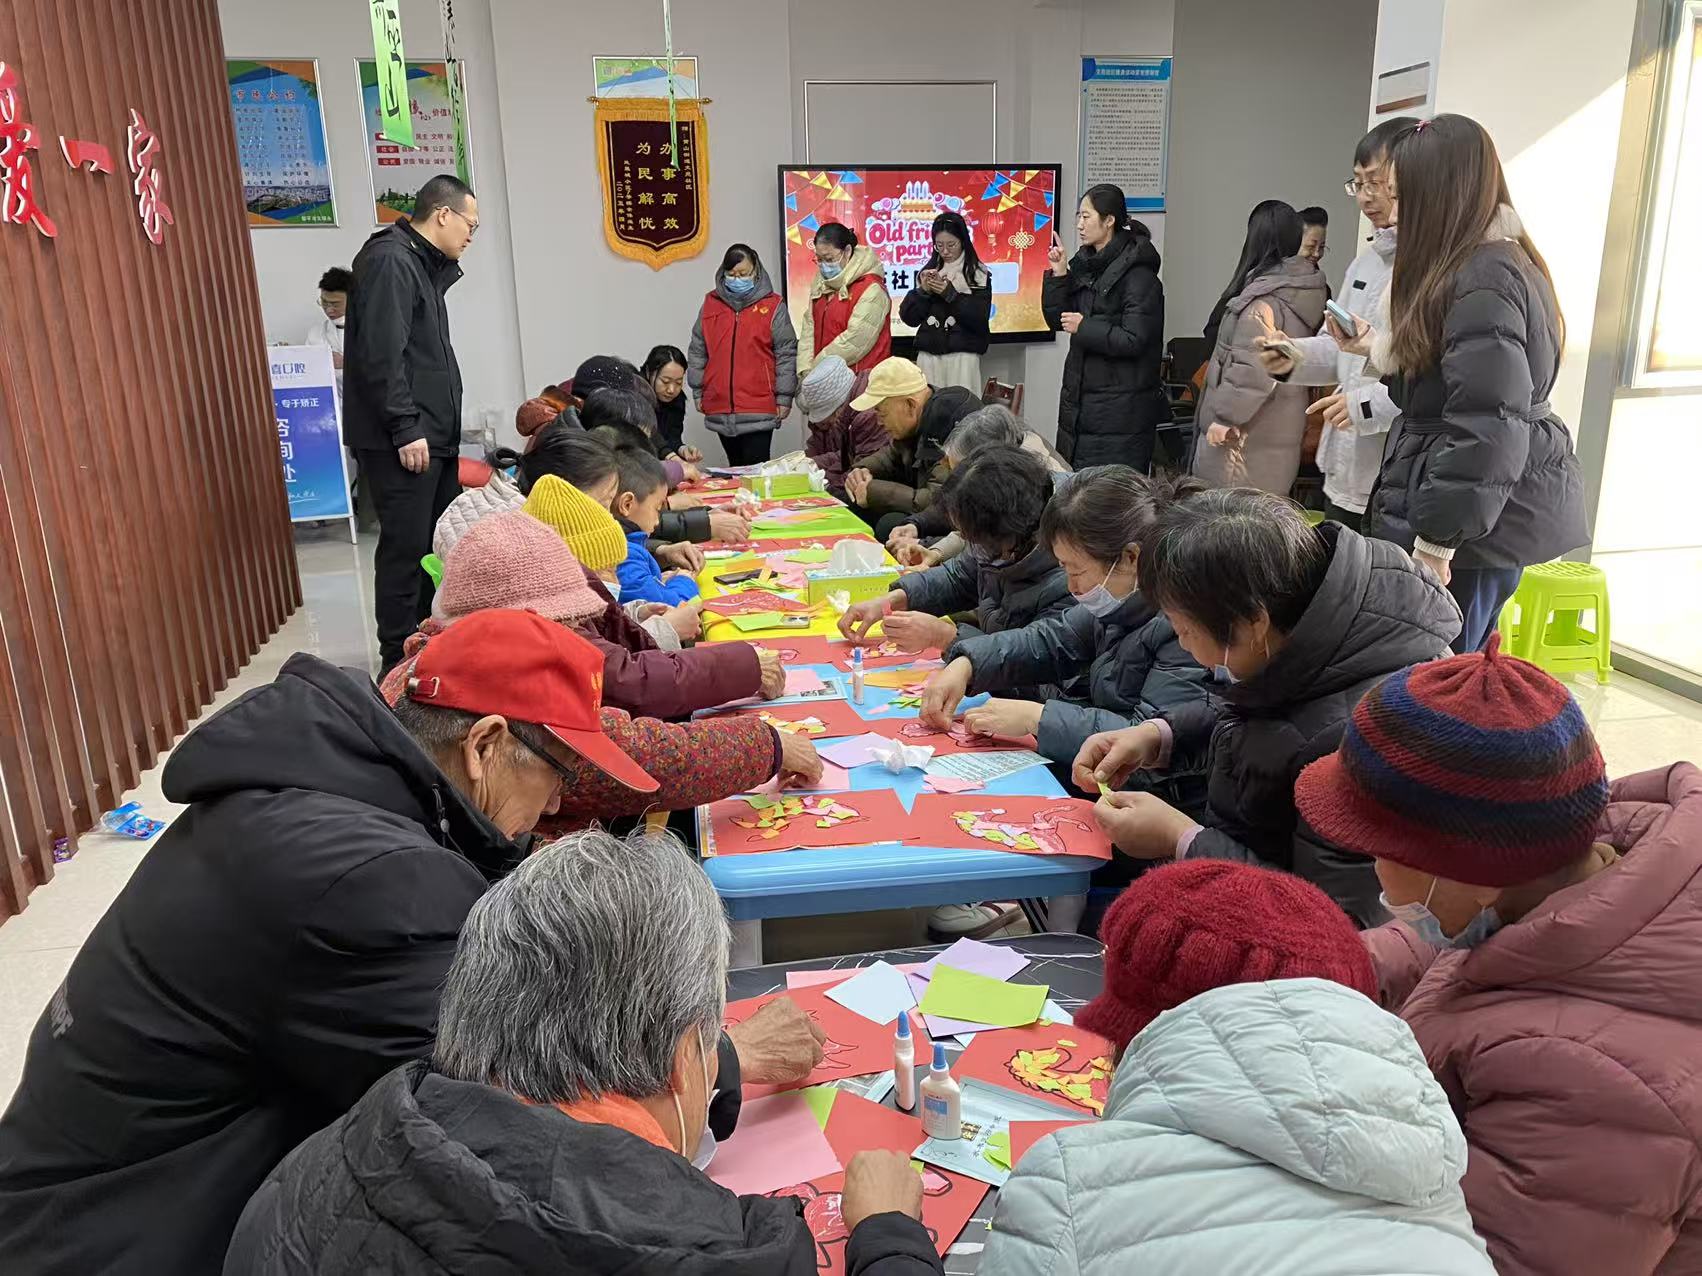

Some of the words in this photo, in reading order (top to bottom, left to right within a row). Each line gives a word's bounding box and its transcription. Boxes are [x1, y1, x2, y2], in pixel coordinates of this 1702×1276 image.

[635, 142, 656, 230] 为民解忧
[659, 142, 680, 230] 办事高效
[870, 221, 904, 244] Old
[896, 243, 933, 262] part
